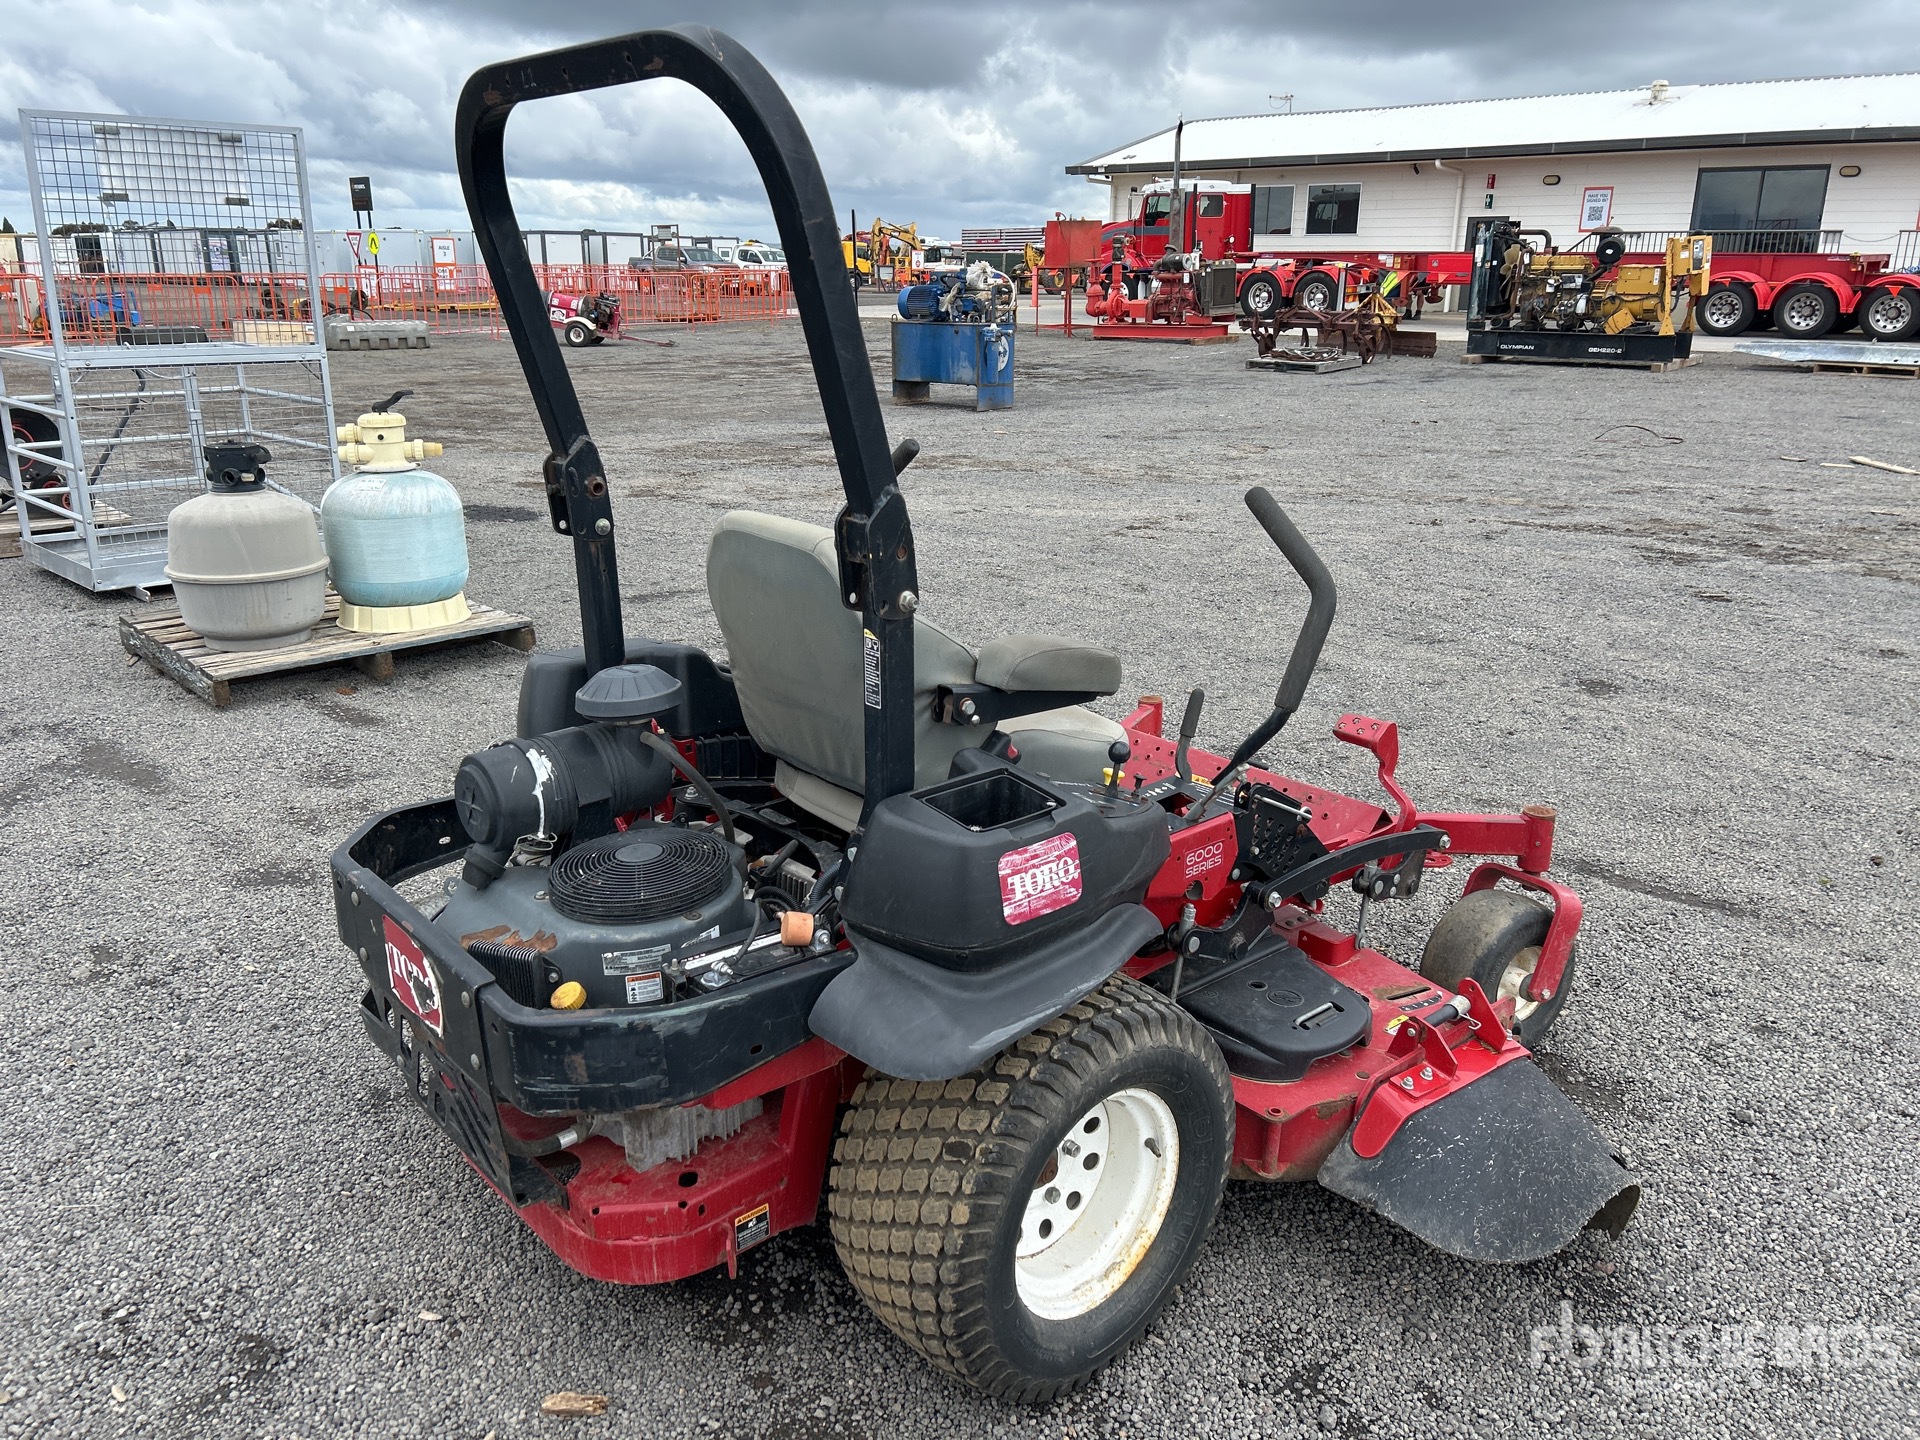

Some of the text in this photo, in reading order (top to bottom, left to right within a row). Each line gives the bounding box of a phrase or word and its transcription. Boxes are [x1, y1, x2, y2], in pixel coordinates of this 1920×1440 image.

[1186, 842, 1223, 866] 6000
[1007, 857, 1075, 900] TORO
[1185, 855, 1222, 879] SERIES
[742, 1206, 767, 1221] WARNING
